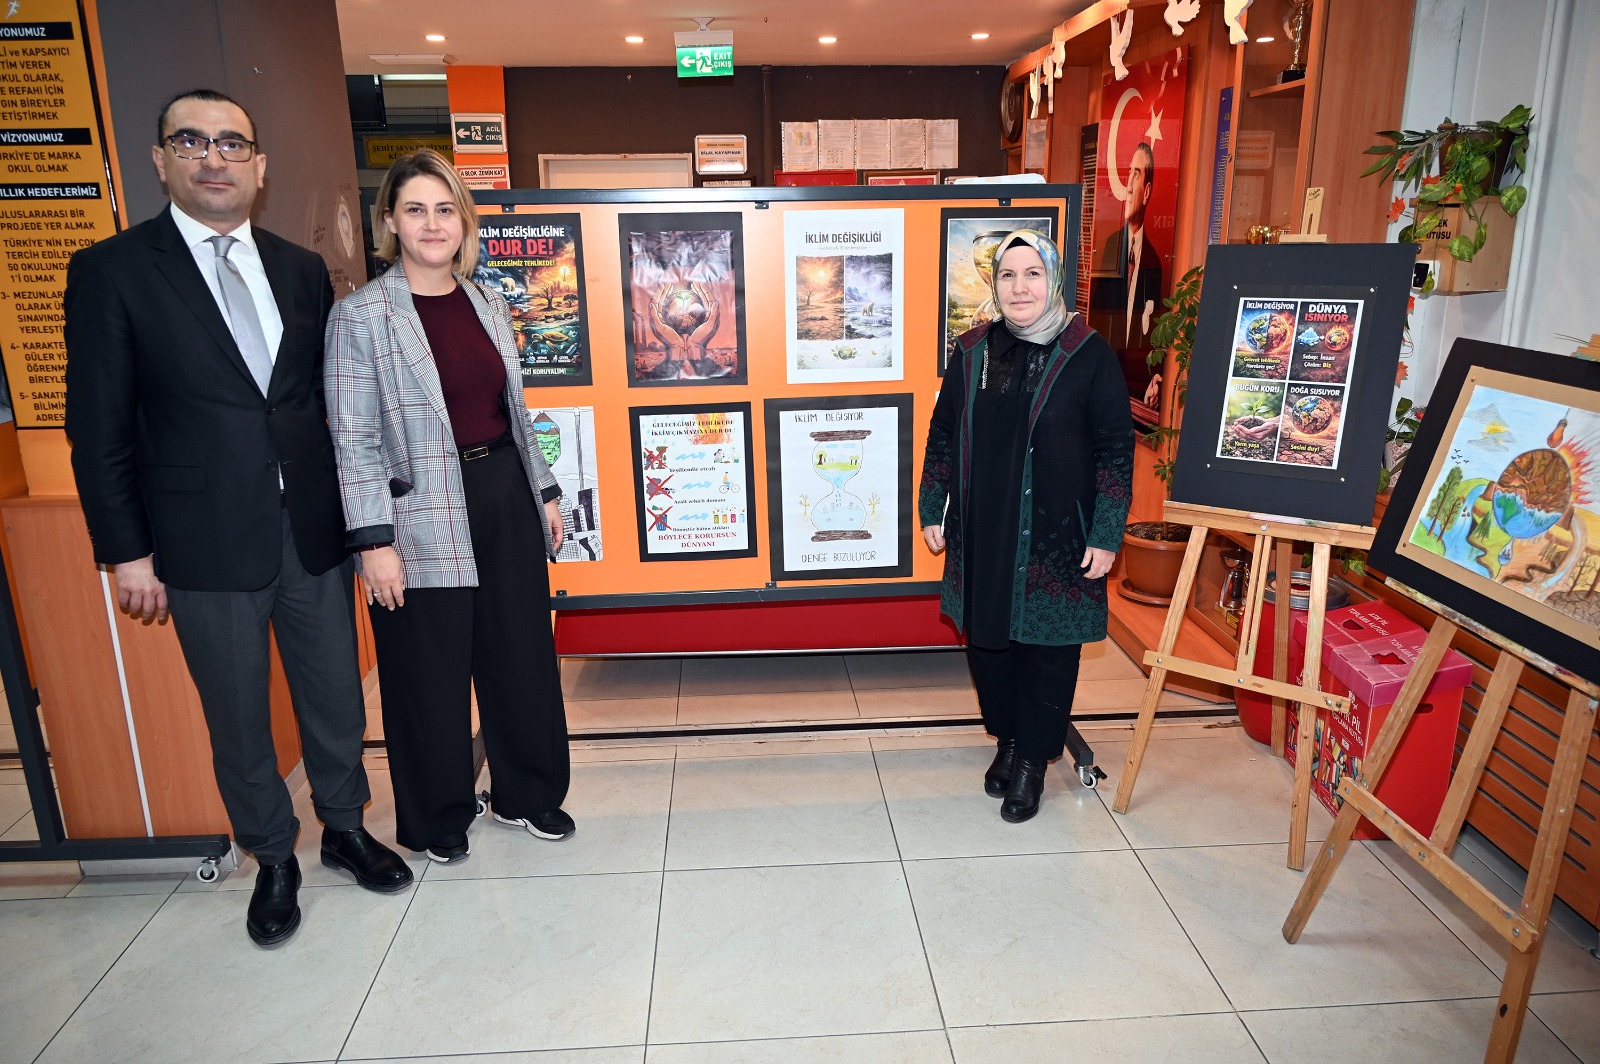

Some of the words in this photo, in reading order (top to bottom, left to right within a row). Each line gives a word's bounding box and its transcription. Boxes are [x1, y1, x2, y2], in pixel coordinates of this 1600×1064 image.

[9, 49, 20, 57] ve
[22, 47, 70, 57] KAPSAYICI
[713, 52, 732, 60] EXIT
[19, 60, 52, 69] VEREN
[713, 60, 732, 69] ÇIKIŞ
[23, 73, 64, 84] OLARAK,
[8, 86, 43, 95] REFAHI
[44, 85, 64, 97] İÇİN
[20, 97, 66, 108] BİREYLER
[0, 110, 59, 122] ETİŞTİRMEK
[485, 124, 501, 132] ACİL
[0, 131, 65, 143] VİZYONUMUZ
[48, 151, 81, 161] MARKA
[8, 164, 34, 173] OKUL
[35, 163, 69, 173] OLMAK
[27, 185, 98, 197] HEDEFLERİMİZ
[70, 207, 85, 218] BİR
[0, 222, 42, 231] PROJEDE
[44, 222, 64, 230] YER
[64, 221, 96, 230] ALMAK
[502, 225, 565, 240] DEĞİŞİKLİĞİNE
[805, 231, 829, 244] İKLİM
[831, 230, 882, 245] DEĞİŞİKLİĞİ
[3, 236, 63, 248] TÜRKİYE'NİN
[65, 238, 77, 247] EN
[78, 238, 96, 249] ÇOK
[488, 239, 523, 256] DUR
[526, 238, 555, 255] DE!
[6, 248, 39, 260] TERCİH
[41, 248, 74, 259] EDİLEN
[8, 263, 19, 271] 50
[487, 258, 524, 268] GELECEĞİMİZ
[524, 258, 556, 267] TEHLİKEDE!
[23, 274, 56, 283] OLMAK
[1, 291, 11, 300] 3-
[13, 291, 66, 300] MEZUNLAR
[15, 302, 53, 311] OLARAK
[1246, 300, 1265, 311] İKLİM
[1265, 301, 1295, 311] DEĞİŞİYOR
[1308, 302, 1348, 314] DÜNYA
[17, 314, 66, 323] SINAVINDA
[10, 342, 20, 350] 4-
[24, 351, 54, 362] GÜLER
[1235, 382, 1259, 393] BUGÜN
[1260, 385, 1281, 394] KORU
[1290, 384, 1310, 396] DOĞA
[1310, 387, 1341, 397] SUSUYOR
[19, 391, 29, 400] 5-
[794, 412, 818, 423] İKLİM
[658, 533, 693, 541] BÖYLECE
[694, 531, 737, 540] KORURSUN
[681, 541, 715, 549] DÜNYANI
[1351, 715, 1362, 735] PİL
